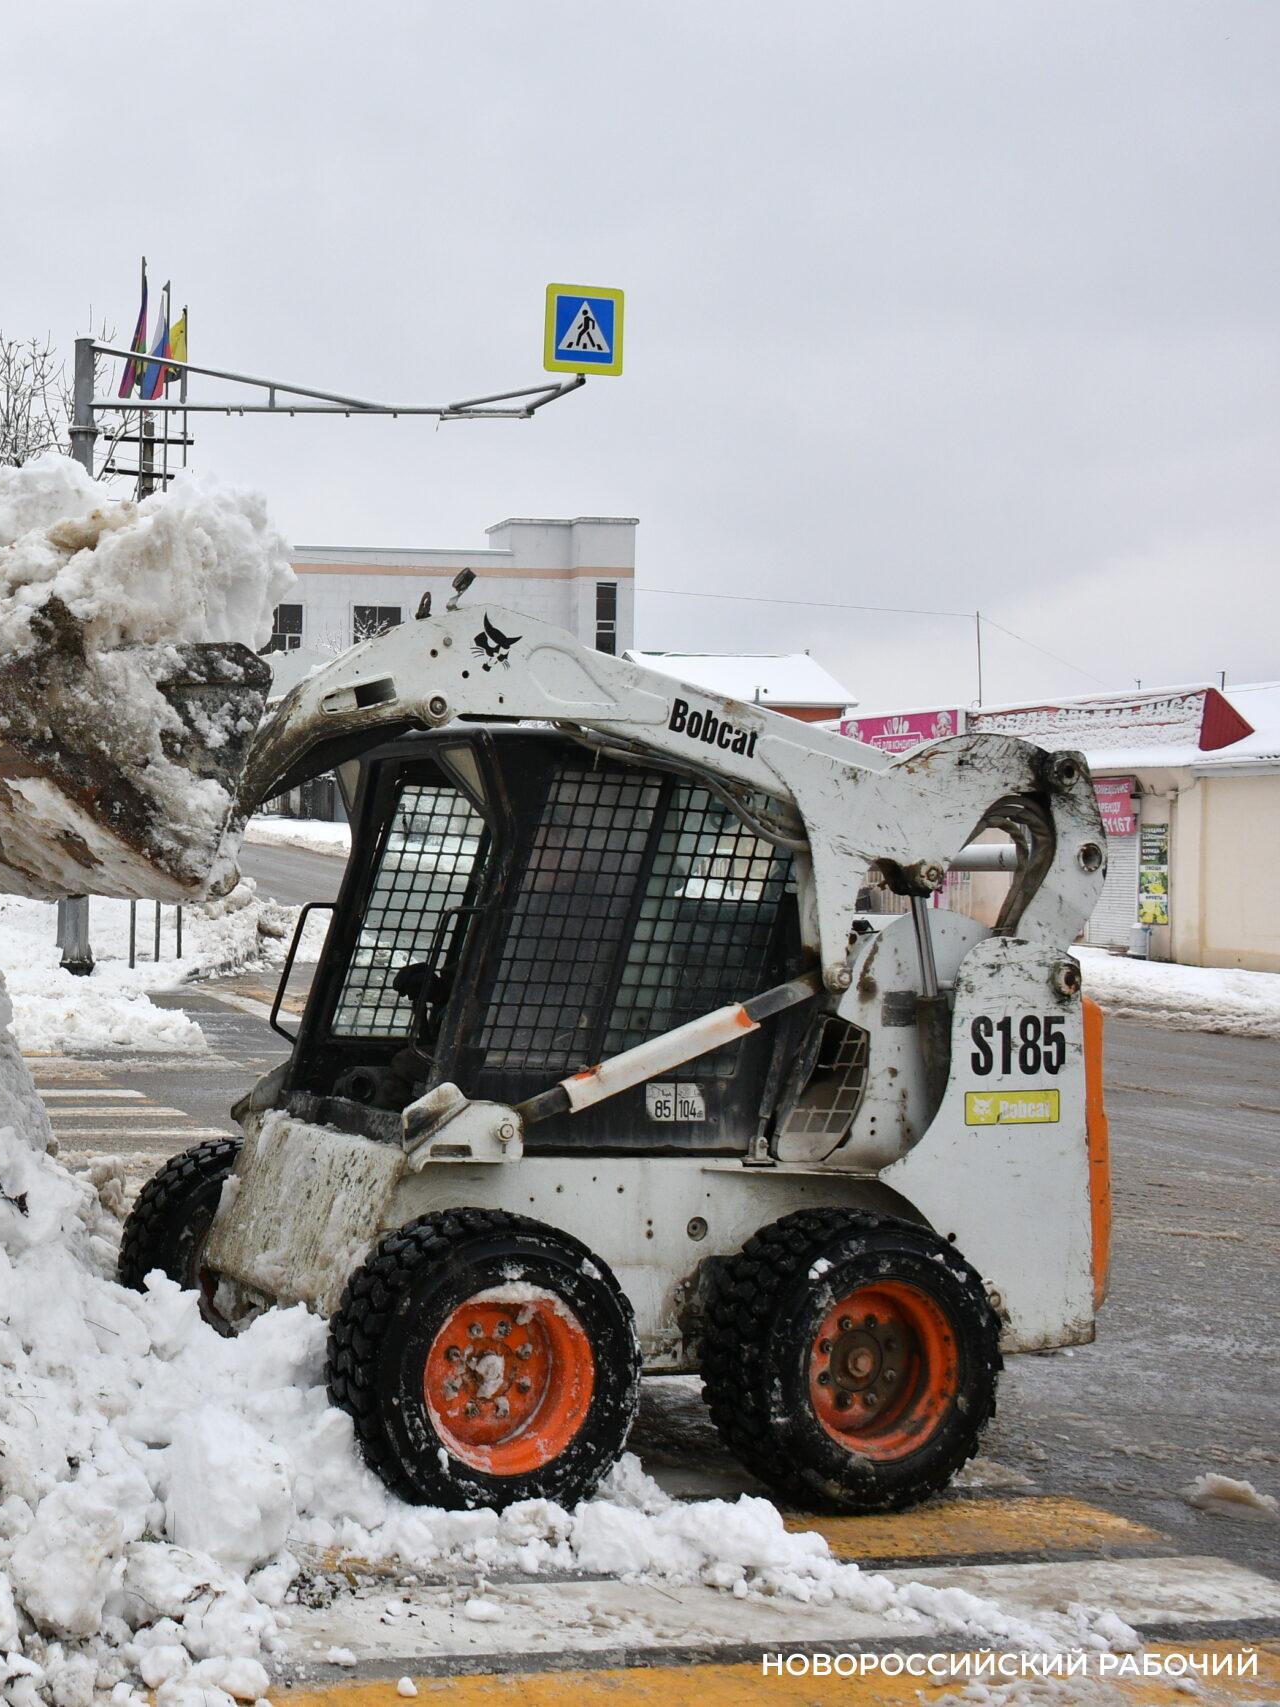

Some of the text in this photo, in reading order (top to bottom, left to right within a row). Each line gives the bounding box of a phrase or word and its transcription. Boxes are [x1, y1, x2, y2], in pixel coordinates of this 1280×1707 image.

[668, 697, 758, 759] Bobcat
[970, 1015, 1066, 1077] S185
[655, 1100, 671, 1118] 85
[679, 1099, 697, 1118] 104
